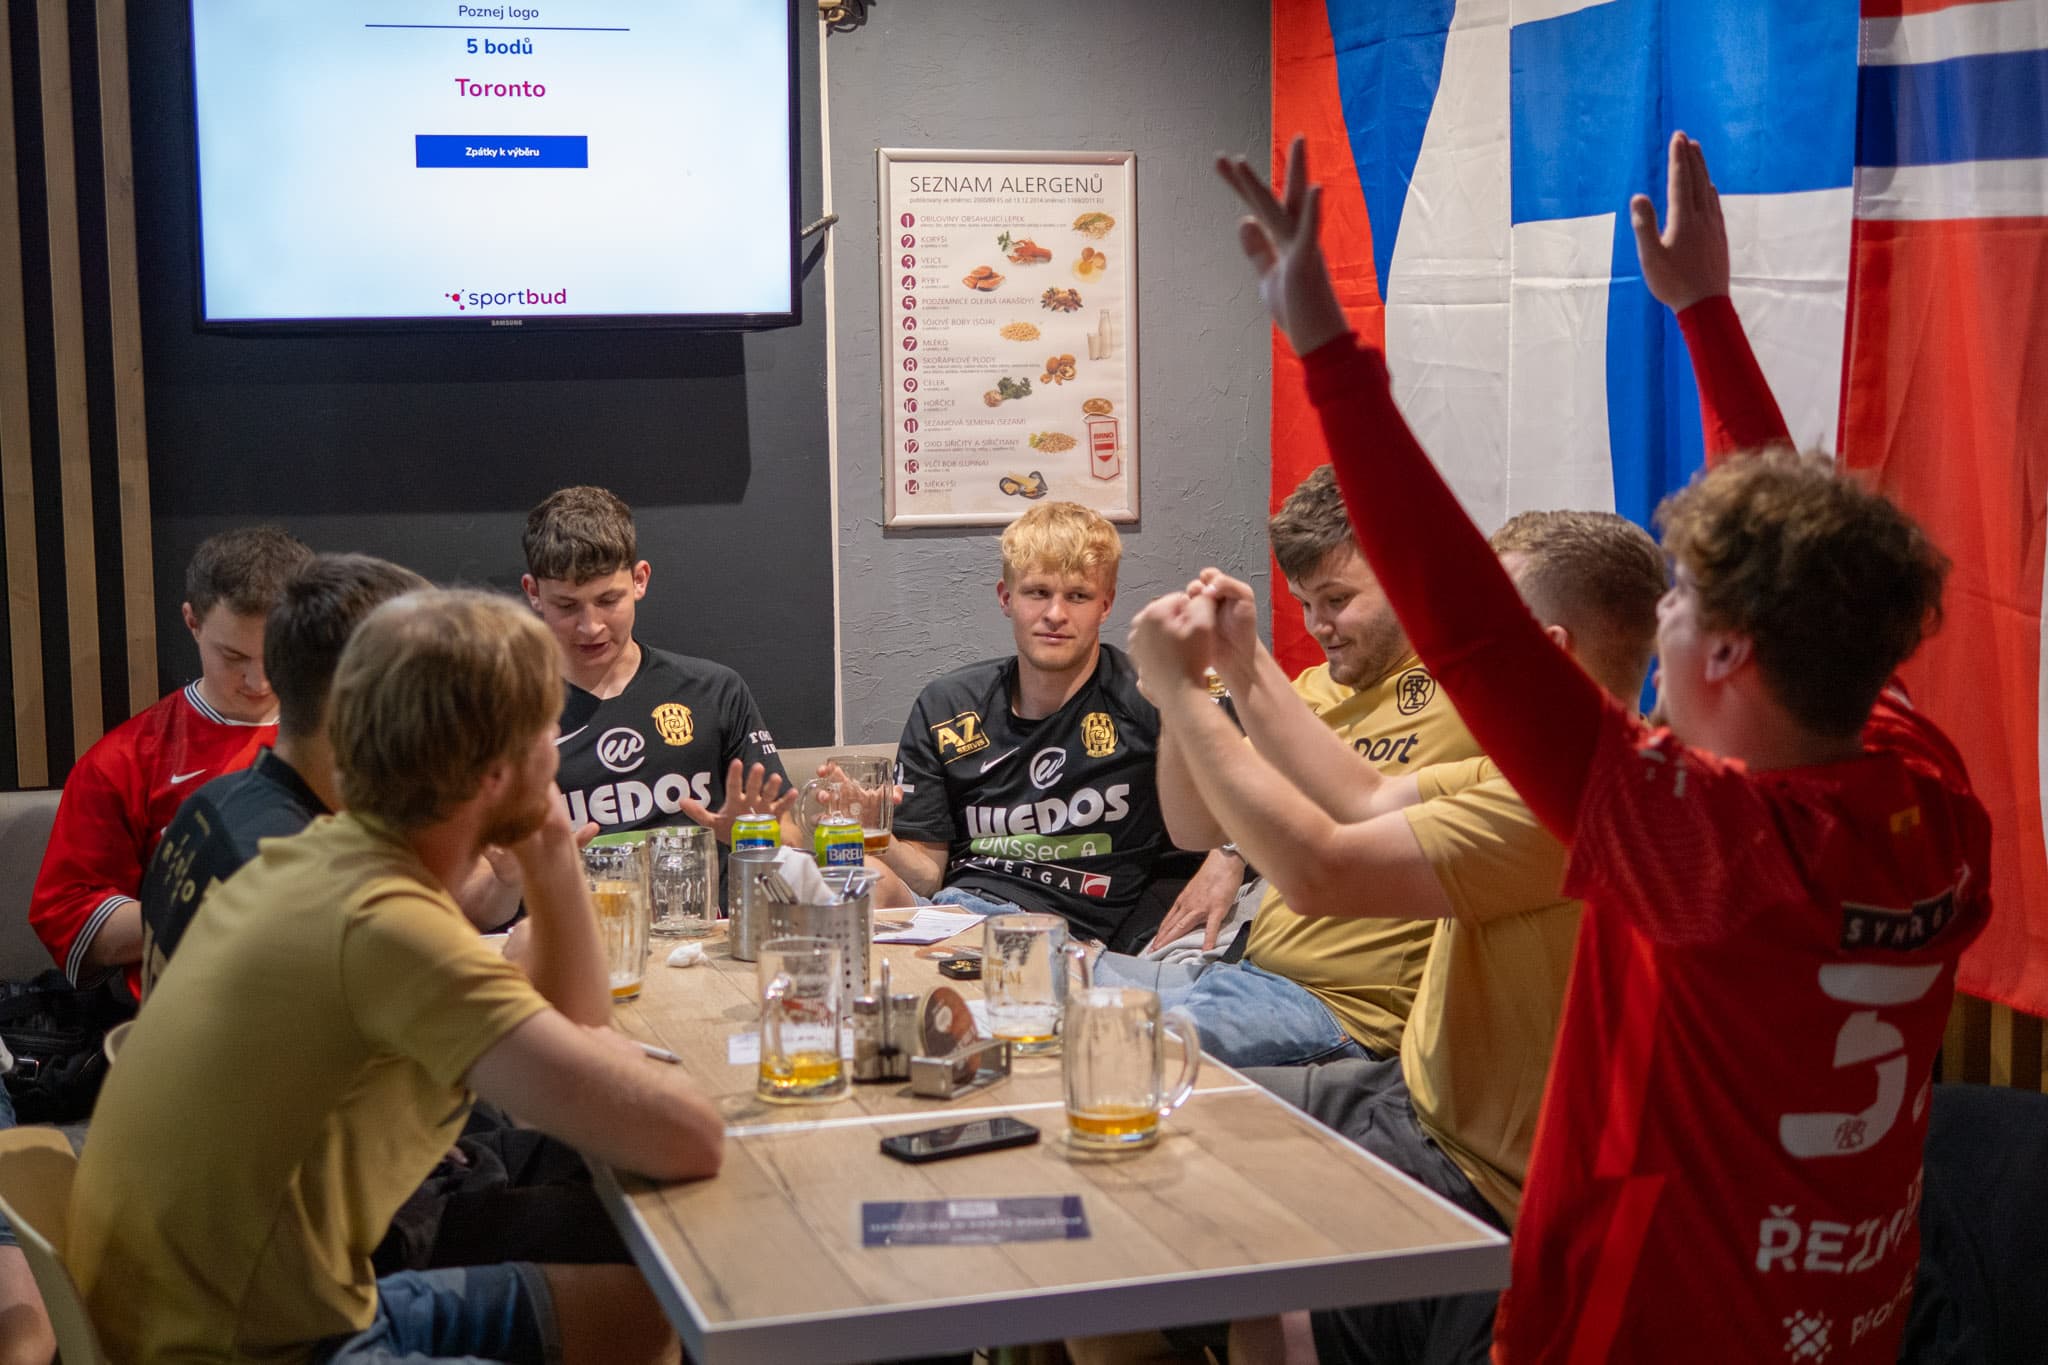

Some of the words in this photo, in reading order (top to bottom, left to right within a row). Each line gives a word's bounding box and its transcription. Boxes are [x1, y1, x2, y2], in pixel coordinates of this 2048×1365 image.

[458, 5, 504, 20] Poznej
[508, 5, 540, 21] logo
[466, 39, 478, 54] 5
[483, 37, 533, 55] bodů
[455, 78, 547, 98] Toronto
[465, 146, 498, 158] Zpátky
[500, 146, 505, 157] k
[507, 146, 540, 158] výběru
[910, 176, 992, 193] SEZNAM
[1000, 173, 1103, 194] ALERGENŮ
[903, 235, 914, 249] 2
[903, 256, 914, 269] 3
[903, 276, 915, 291] 4
[468, 288, 567, 309] sportbud
[904, 296, 915, 311] 5
[491, 319, 523, 327] SAMSUNG
[905, 317, 916, 331] 6
[904, 337, 916, 351] 7
[905, 358, 916, 372] 8
[905, 378, 916, 392] 9
[905, 399, 918, 413] 10
[905, 419, 918, 433] 11
[1093, 431, 1114, 440] BRNO
[905, 440, 919, 454] 12
[905, 460, 919, 474] 13
[906, 480, 919, 494] 14
[937, 716, 981, 754] AZ
[956, 739, 985, 754] SERVIS
[966, 784, 1130, 838] WEDOS
